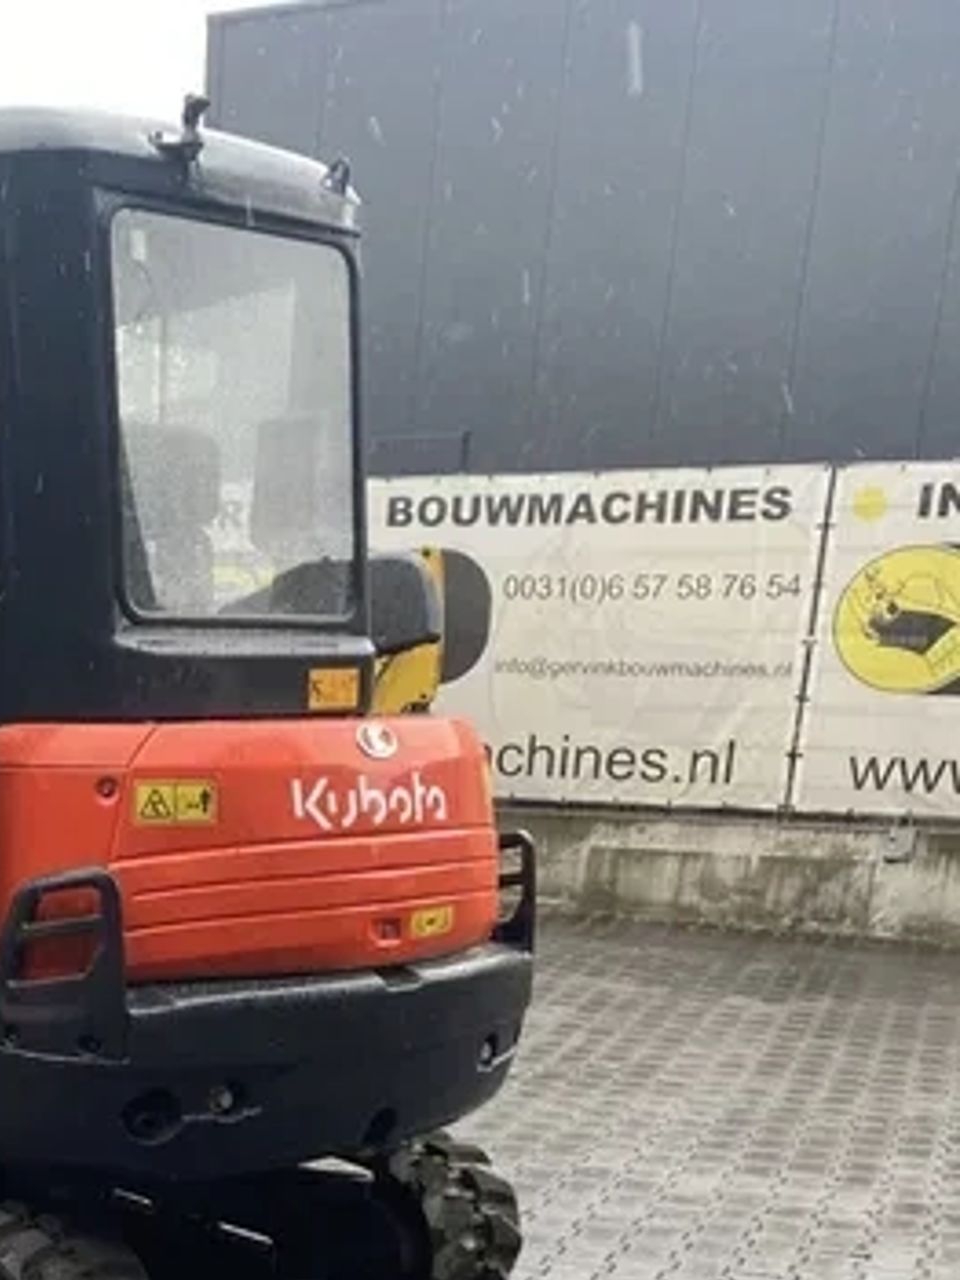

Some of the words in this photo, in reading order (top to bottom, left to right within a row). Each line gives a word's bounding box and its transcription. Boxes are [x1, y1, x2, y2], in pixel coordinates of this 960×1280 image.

[386, 486, 792, 527] BOUWMACHINES
[502, 573, 625, 604] 0031(0)6
[632, 573, 668, 601] 57
[676, 573, 712, 600] 58
[722, 573, 756, 600] 76
[765, 573, 801, 600] 54
[292, 771, 448, 830] Kubota
